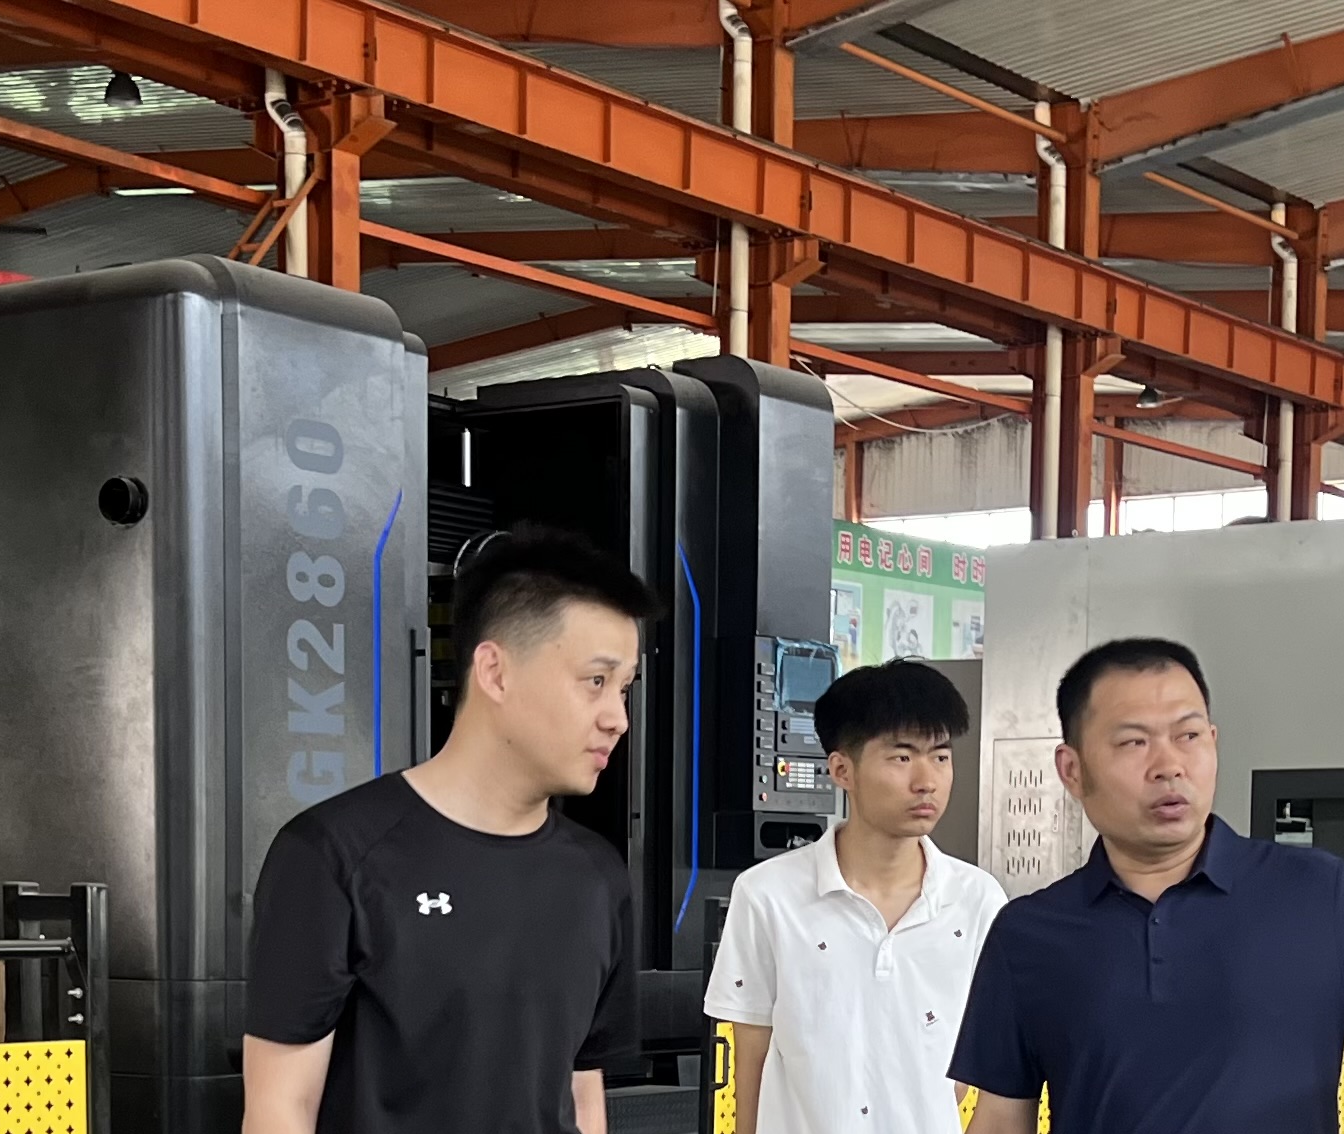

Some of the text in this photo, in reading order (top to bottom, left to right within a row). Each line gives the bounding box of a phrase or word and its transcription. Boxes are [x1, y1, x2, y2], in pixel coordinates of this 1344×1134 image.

[286, 418, 346, 800] GK2860
[837, 531, 933, 578] 用电记心间
